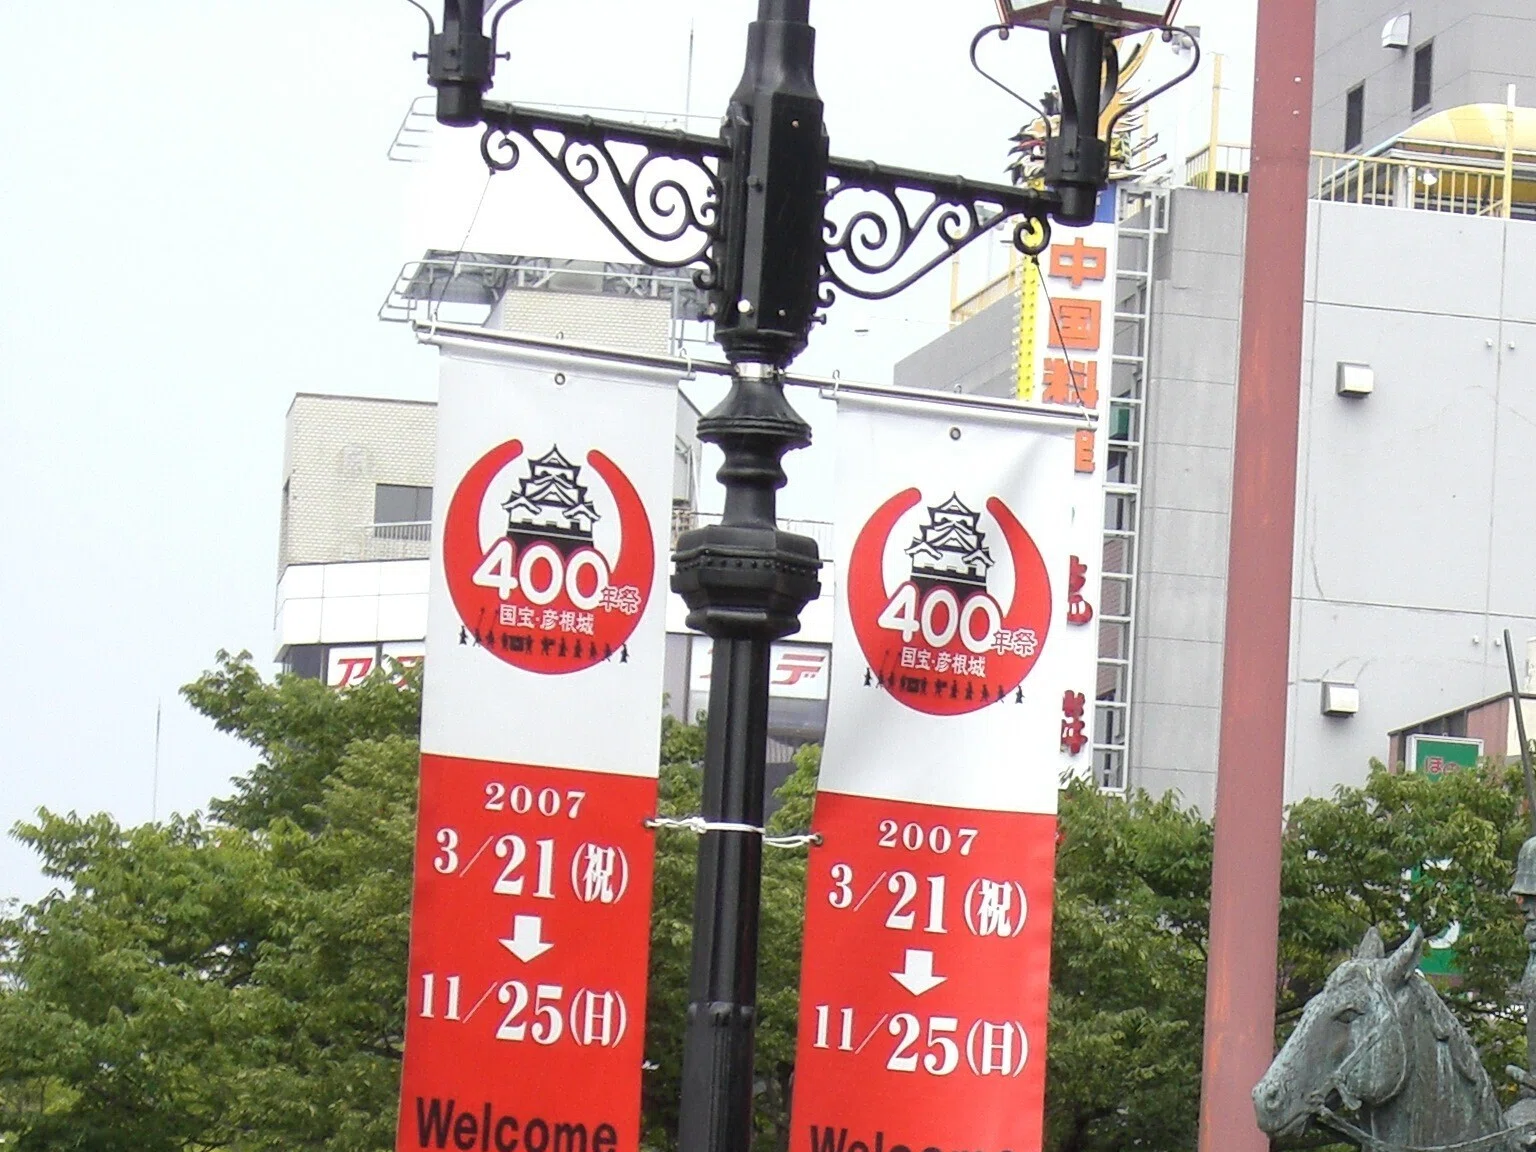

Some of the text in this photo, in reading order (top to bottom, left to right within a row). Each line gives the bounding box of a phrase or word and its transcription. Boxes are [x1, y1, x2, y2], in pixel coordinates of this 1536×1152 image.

[471, 539, 641, 616] 400年祭
[877, 584, 1038, 657] 400年祭
[484, 783, 587, 819] 2007
[878, 819, 979, 857] 2007
